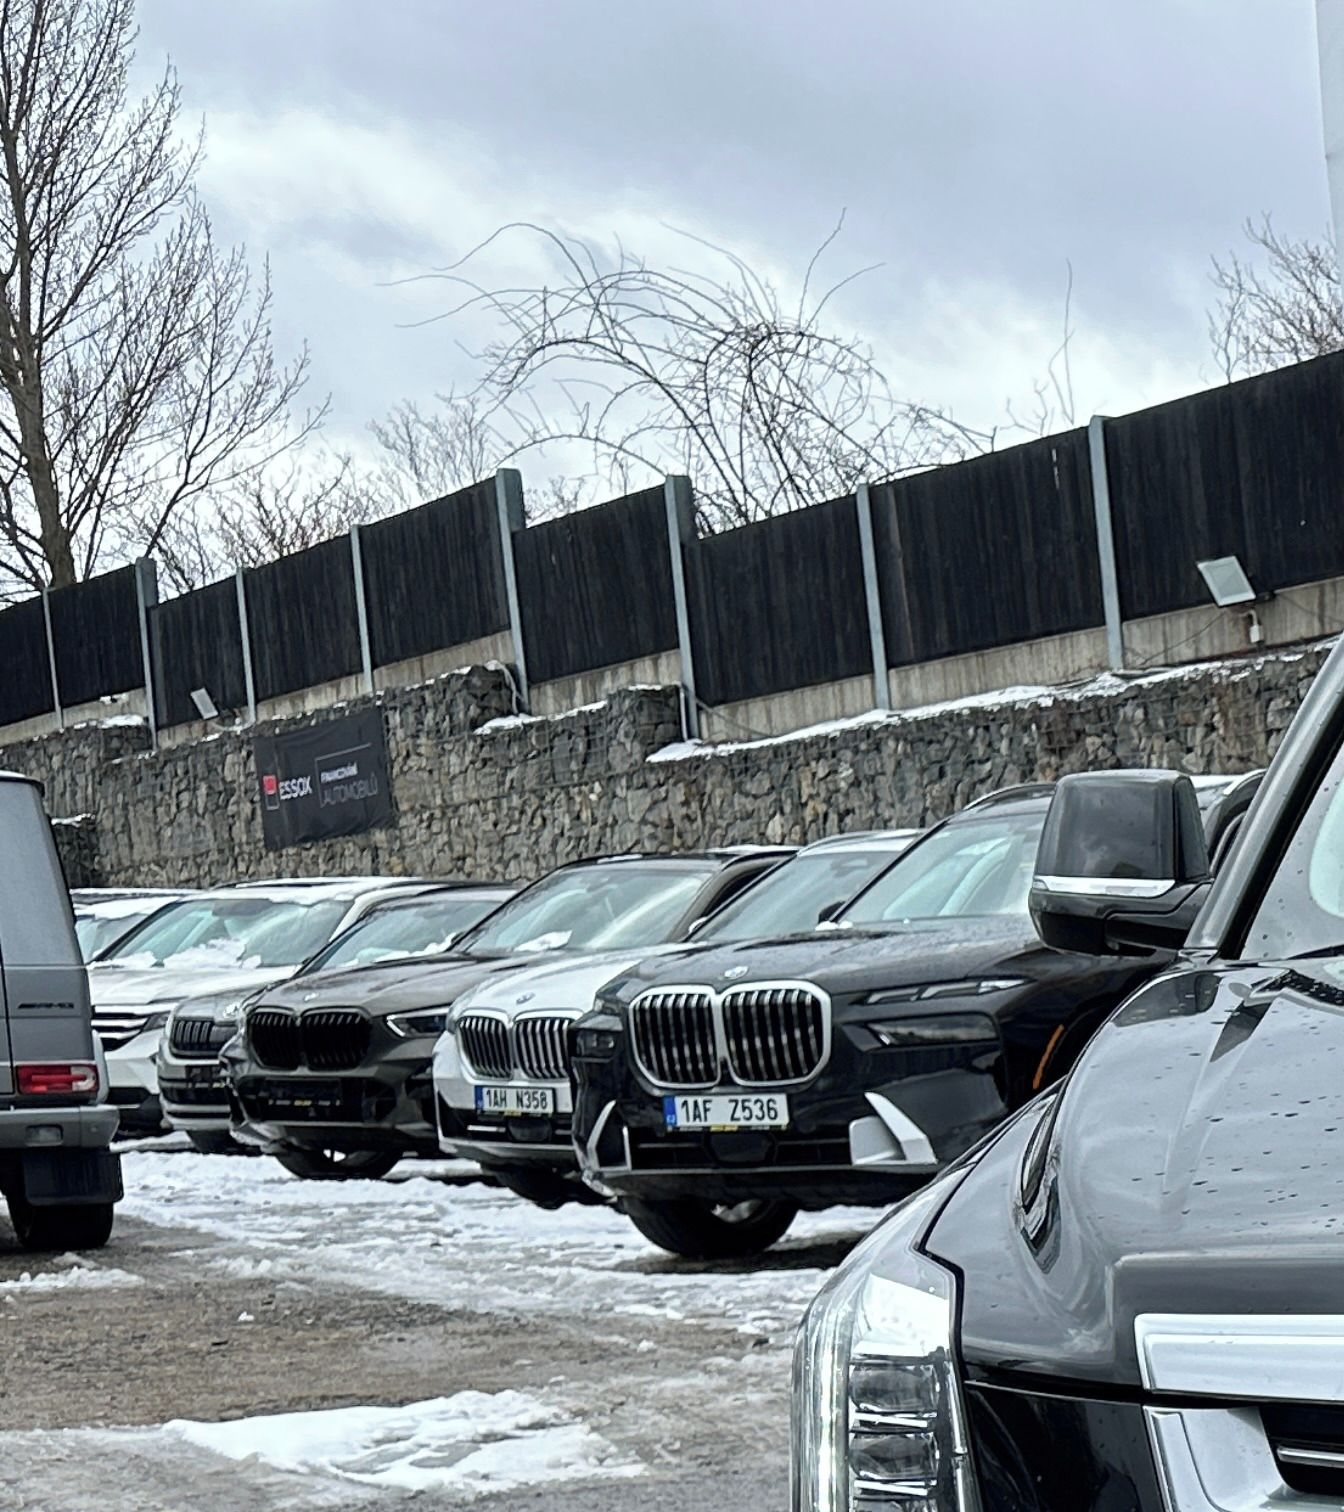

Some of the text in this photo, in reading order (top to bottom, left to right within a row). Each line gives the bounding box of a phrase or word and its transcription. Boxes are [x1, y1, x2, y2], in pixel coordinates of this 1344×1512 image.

[279, 776, 312, 800] ESSOX
[486, 1089, 507, 1107] 1AH
[681, 1099, 712, 1122] 1AF
[728, 1098, 778, 1122] Z536
